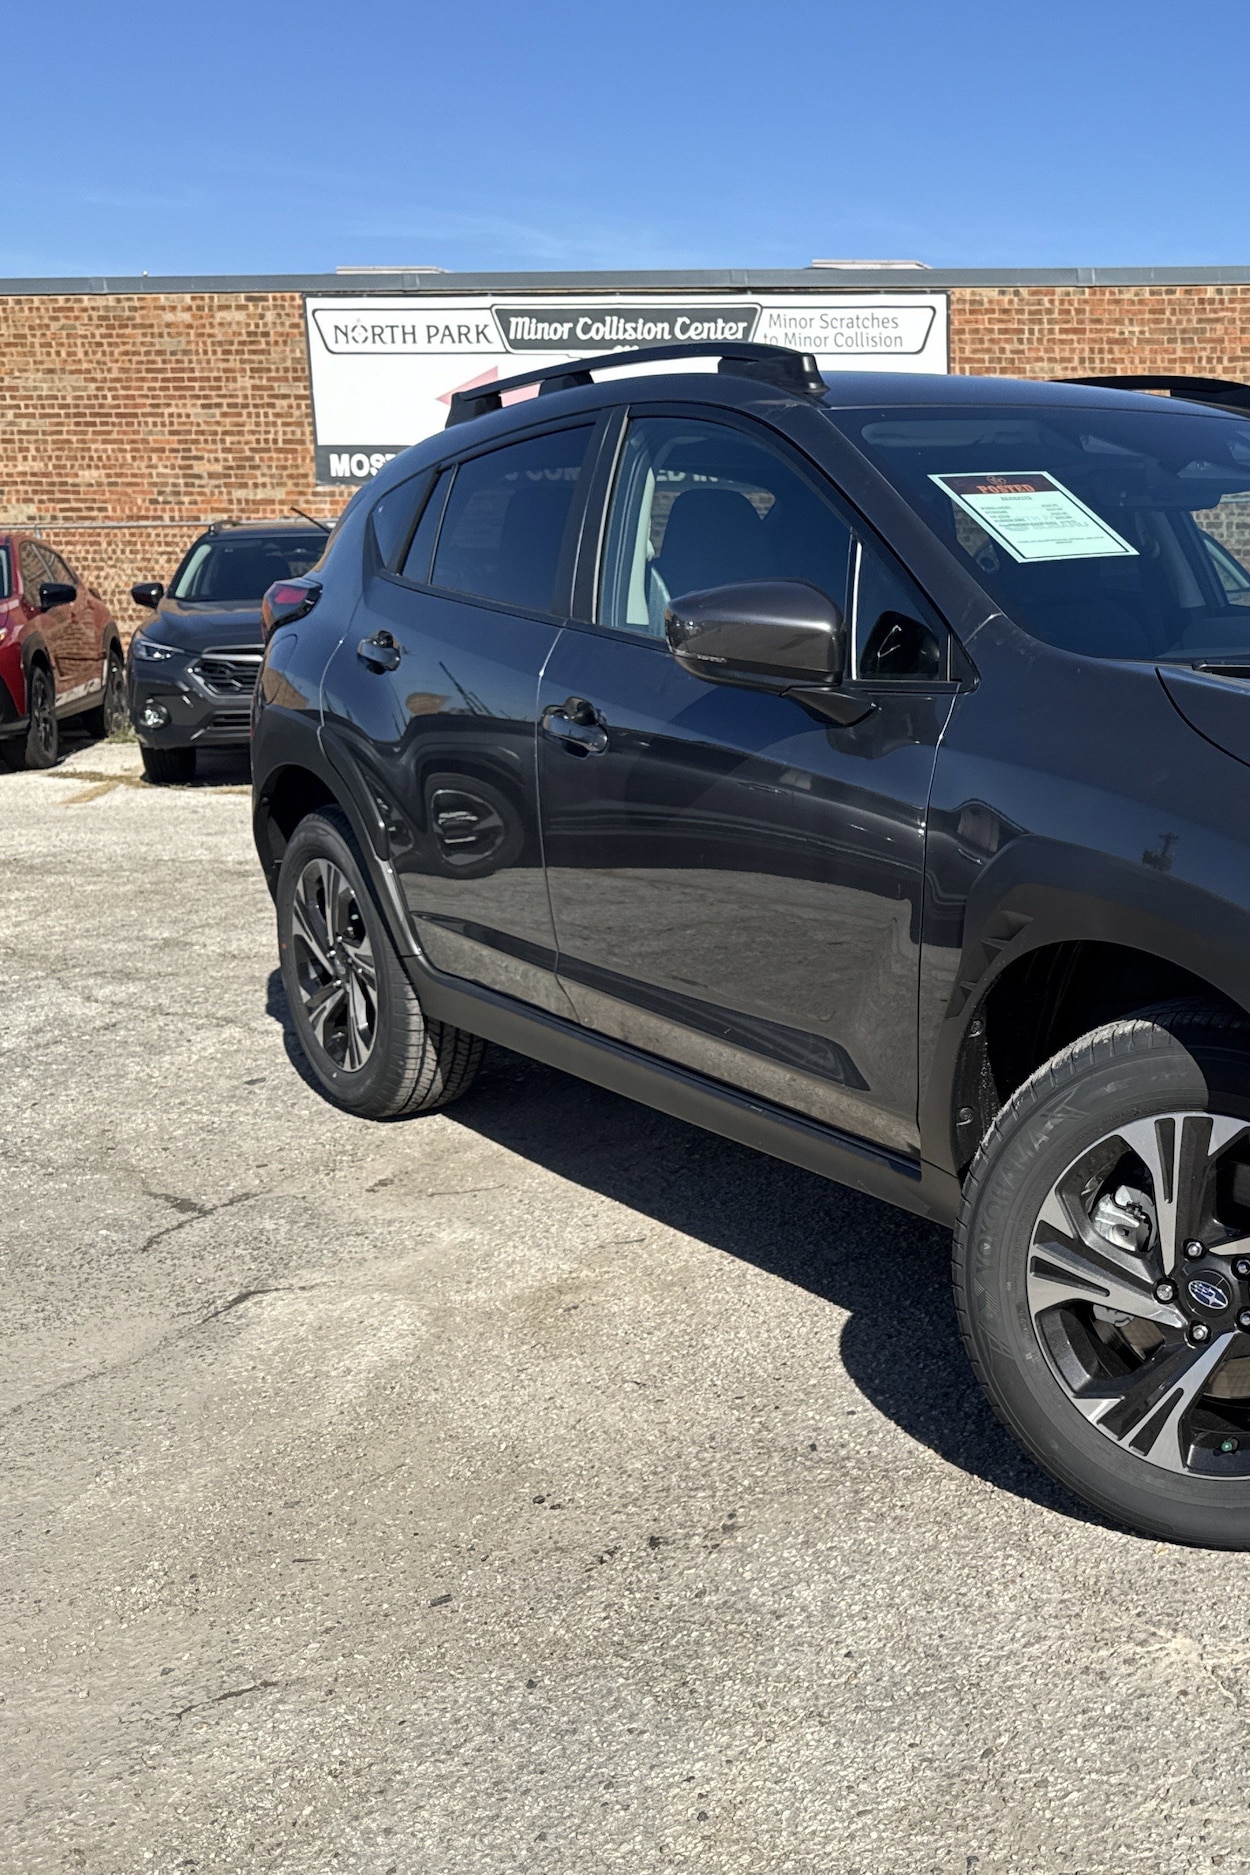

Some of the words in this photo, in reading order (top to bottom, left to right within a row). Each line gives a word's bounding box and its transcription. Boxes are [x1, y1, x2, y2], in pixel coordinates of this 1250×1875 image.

[509, 316, 573, 340] Minor
[576, 316, 672, 340] Collision
[674, 316, 748, 341] Center
[768, 313, 815, 329] Minor
[819, 312, 899, 329] Scratches
[333, 324, 417, 345] NORTH
[426, 324, 494, 344] PARK
[763, 333, 778, 345] to
[784, 332, 829, 347] Minor
[834, 331, 904, 348] Collision
[976, 484, 1036, 494] POSTED
[974, 1127, 1051, 1274] YOKOHAMA
